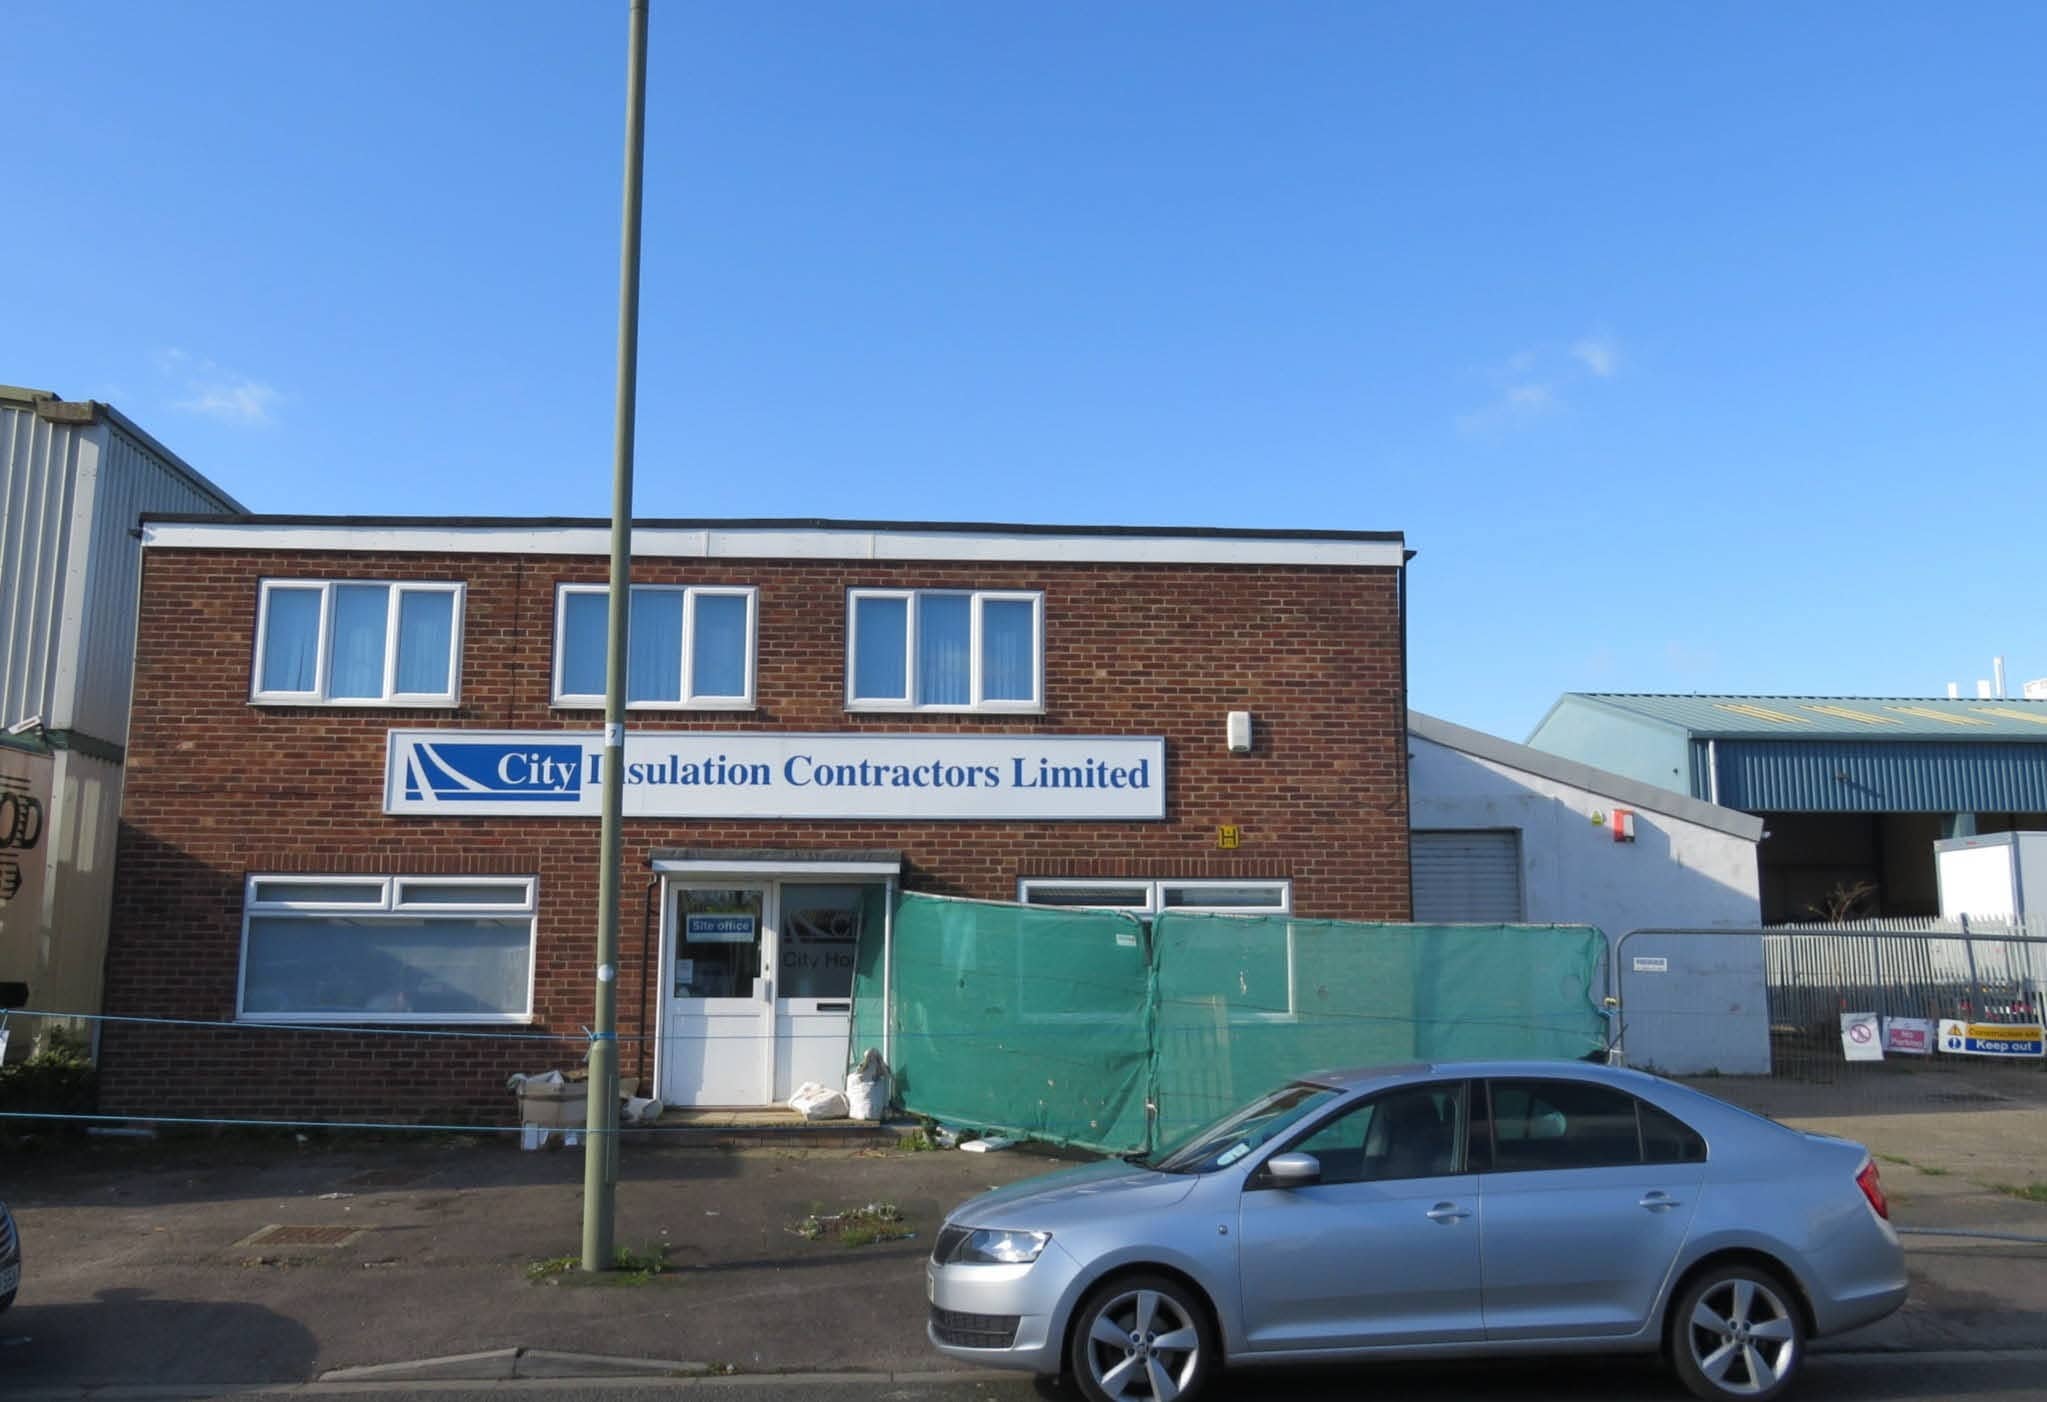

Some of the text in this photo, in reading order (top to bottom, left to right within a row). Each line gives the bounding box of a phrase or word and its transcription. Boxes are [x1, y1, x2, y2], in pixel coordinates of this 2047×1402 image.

[497, 752, 1150, 791] City Isulation Contractors Limited
[692, 920, 750, 931] Site office
[1976, 1039, 2032, 1051] Keep out
